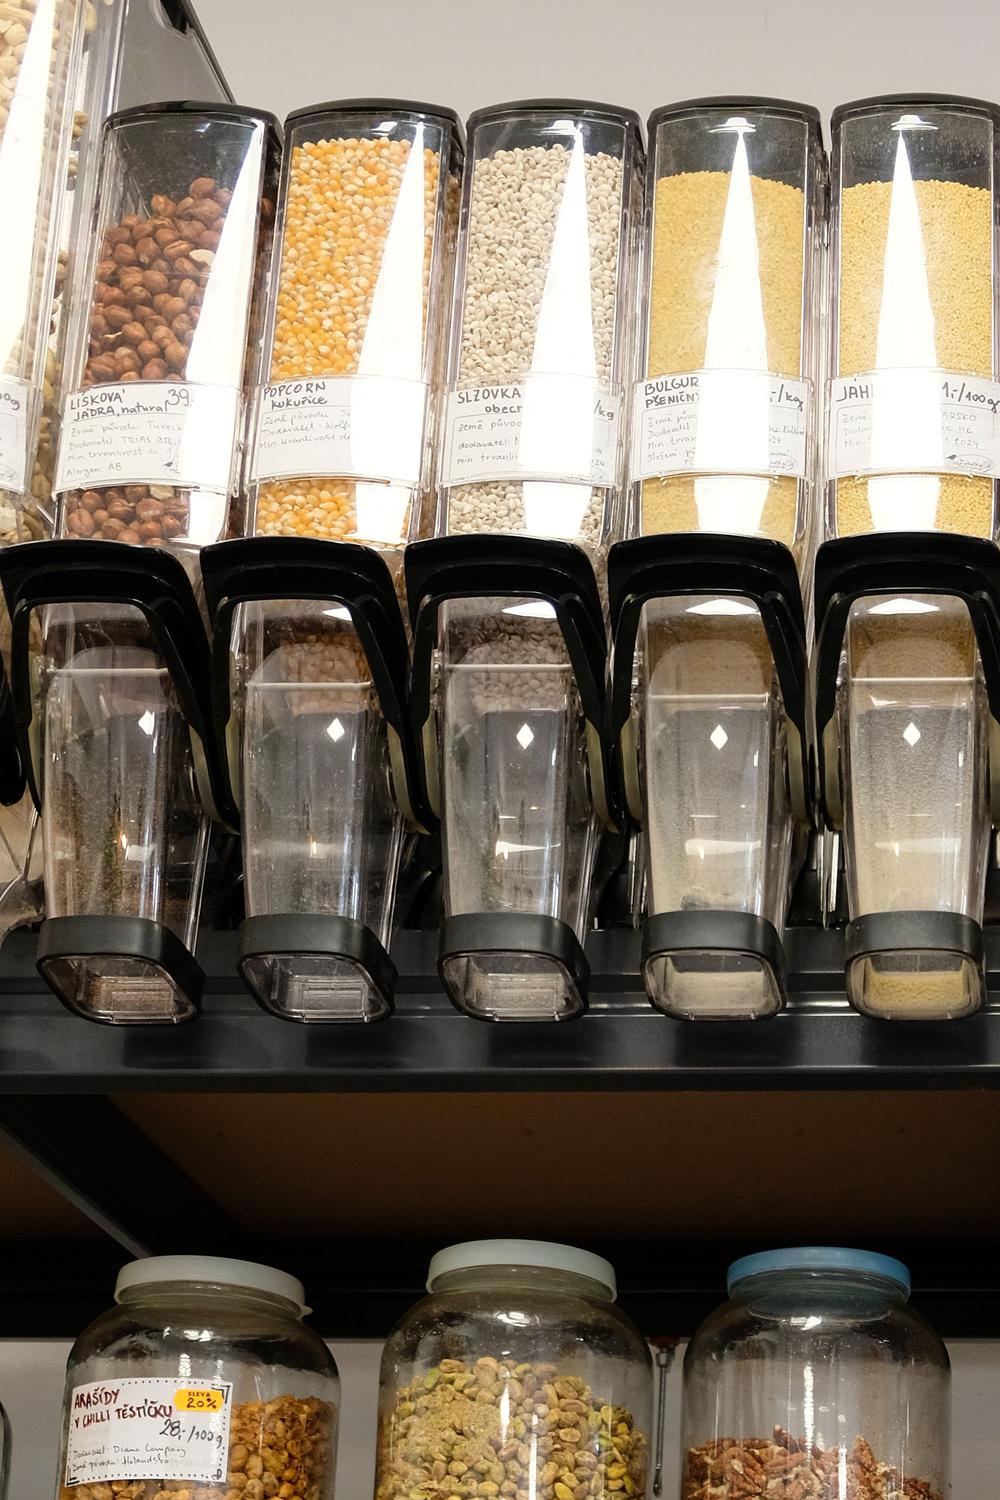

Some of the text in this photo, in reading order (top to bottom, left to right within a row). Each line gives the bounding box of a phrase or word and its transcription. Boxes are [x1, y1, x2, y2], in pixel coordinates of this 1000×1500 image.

[263, 382, 326, 401] POPCORN
[457, 387, 522, 405] SLZOVKA
[644, 377, 699, 397] BULGUR
[271, 396, 328, 411] kukuřice
[74, 1386, 120, 1410] ARAŠÍDY
[185, 1397, 217, 1409] 20%
[82, 1398, 173, 1428] CHILLI TĚSTÍČKU
